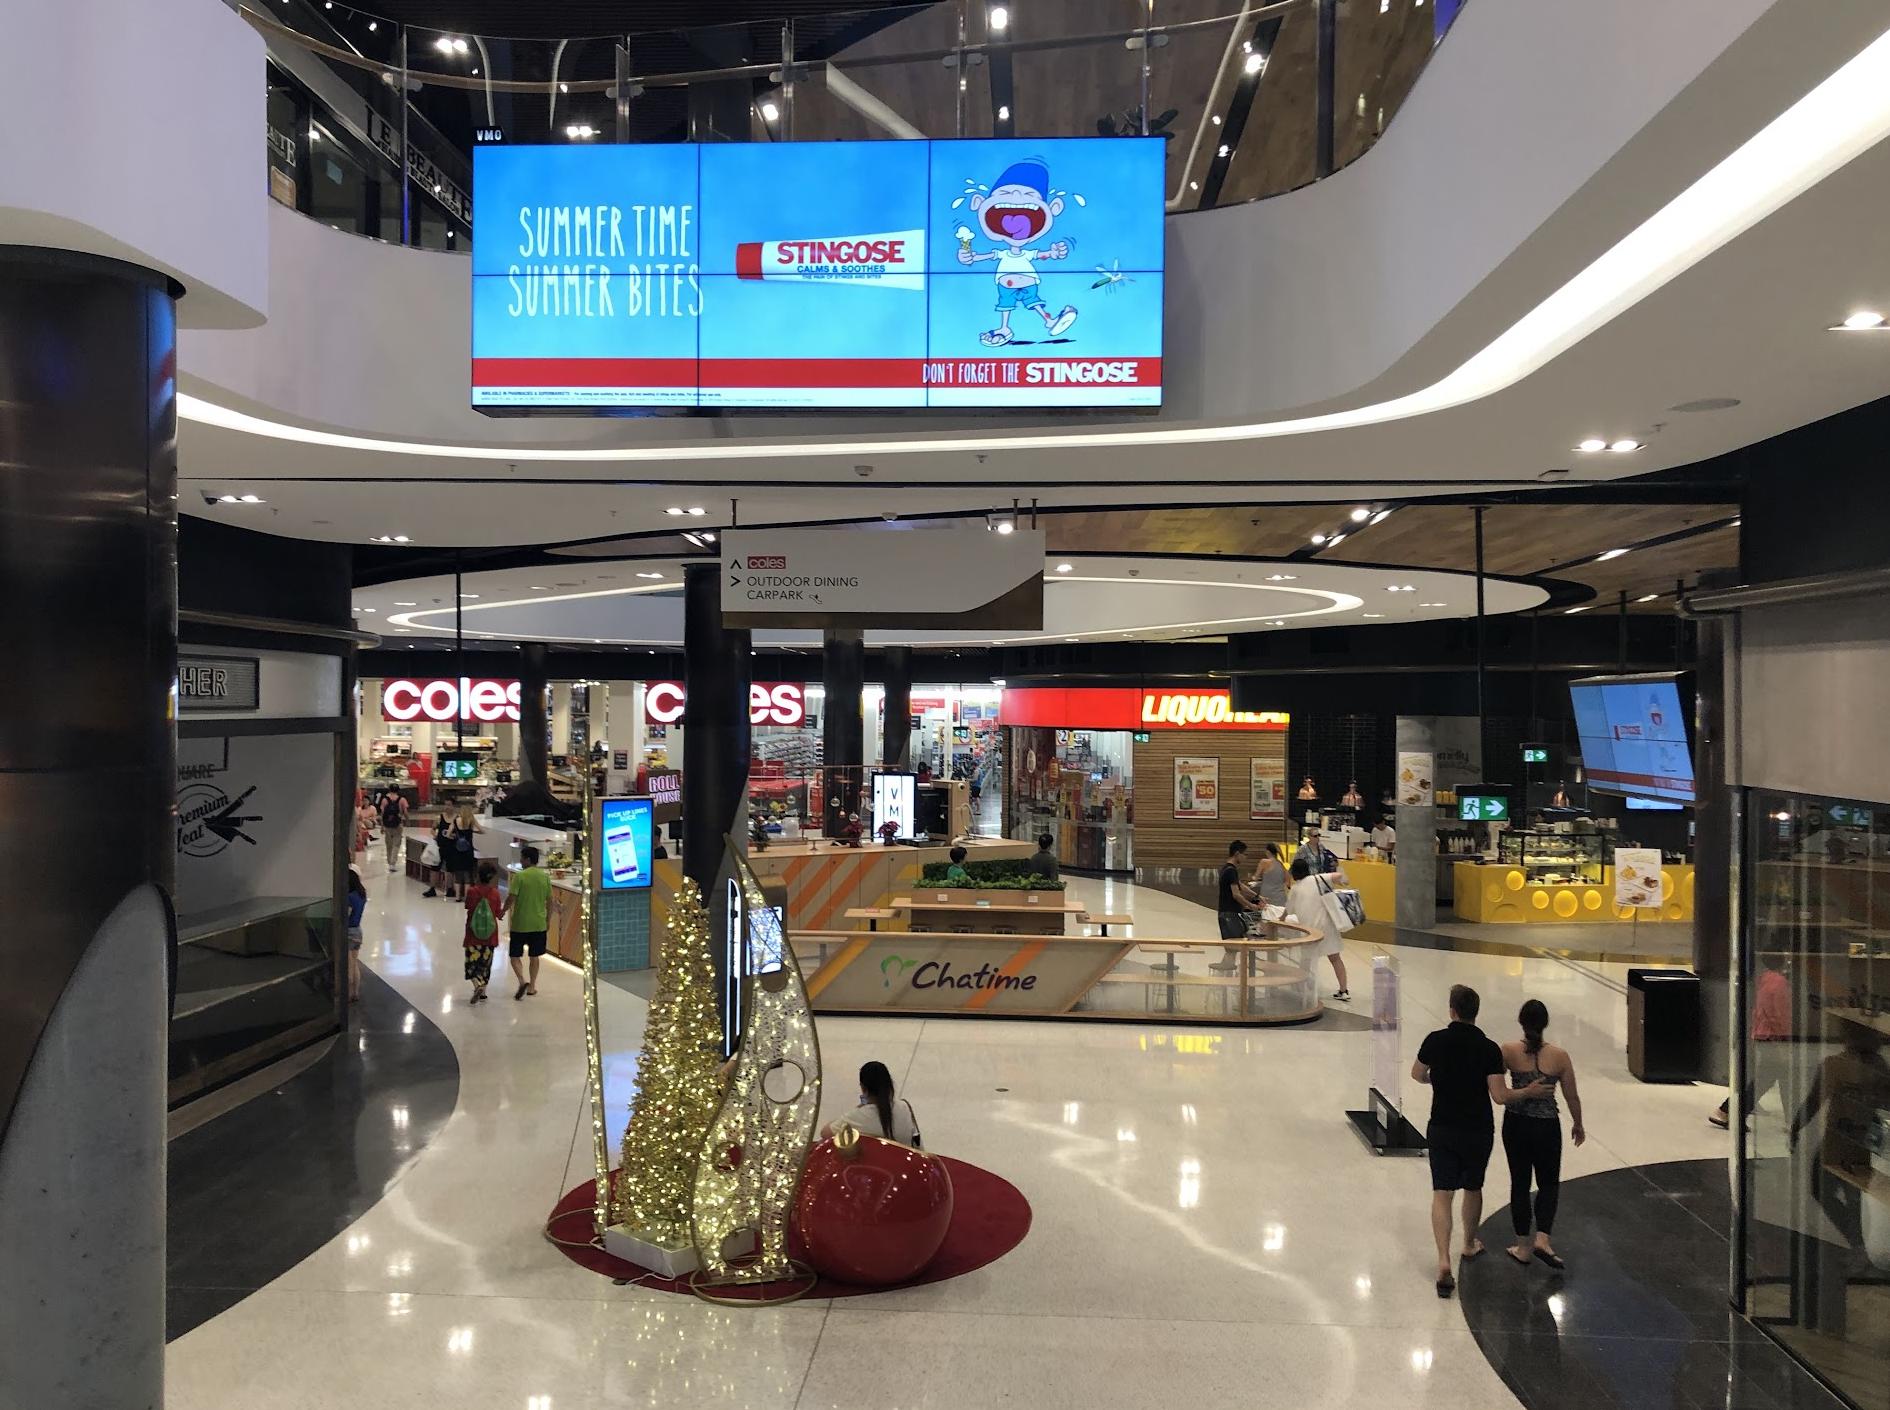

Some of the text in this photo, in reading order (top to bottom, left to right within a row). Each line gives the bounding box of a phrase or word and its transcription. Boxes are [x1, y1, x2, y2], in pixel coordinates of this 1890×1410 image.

[476, 129, 502, 141] VMO
[519, 205, 693, 257] SUMMER TIME
[777, 240, 905, 265] STINGOSE
[797, 264, 886, 273] CALMS & SOOTHES
[508, 263, 704, 317] SUMMER BITES
[922, 362, 1139, 384] DON'T FORGET THE STINGOSE
[748, 557, 785, 569] coles
[747, 576, 859, 587] OUTDOOR DINING
[747, 590, 803, 600] CARPARK
[646, 682, 803, 724] ces
[649, 775, 680, 792] ROLL
[178, 795, 229, 825] remium
[912, 961, 1037, 990] Chatime
